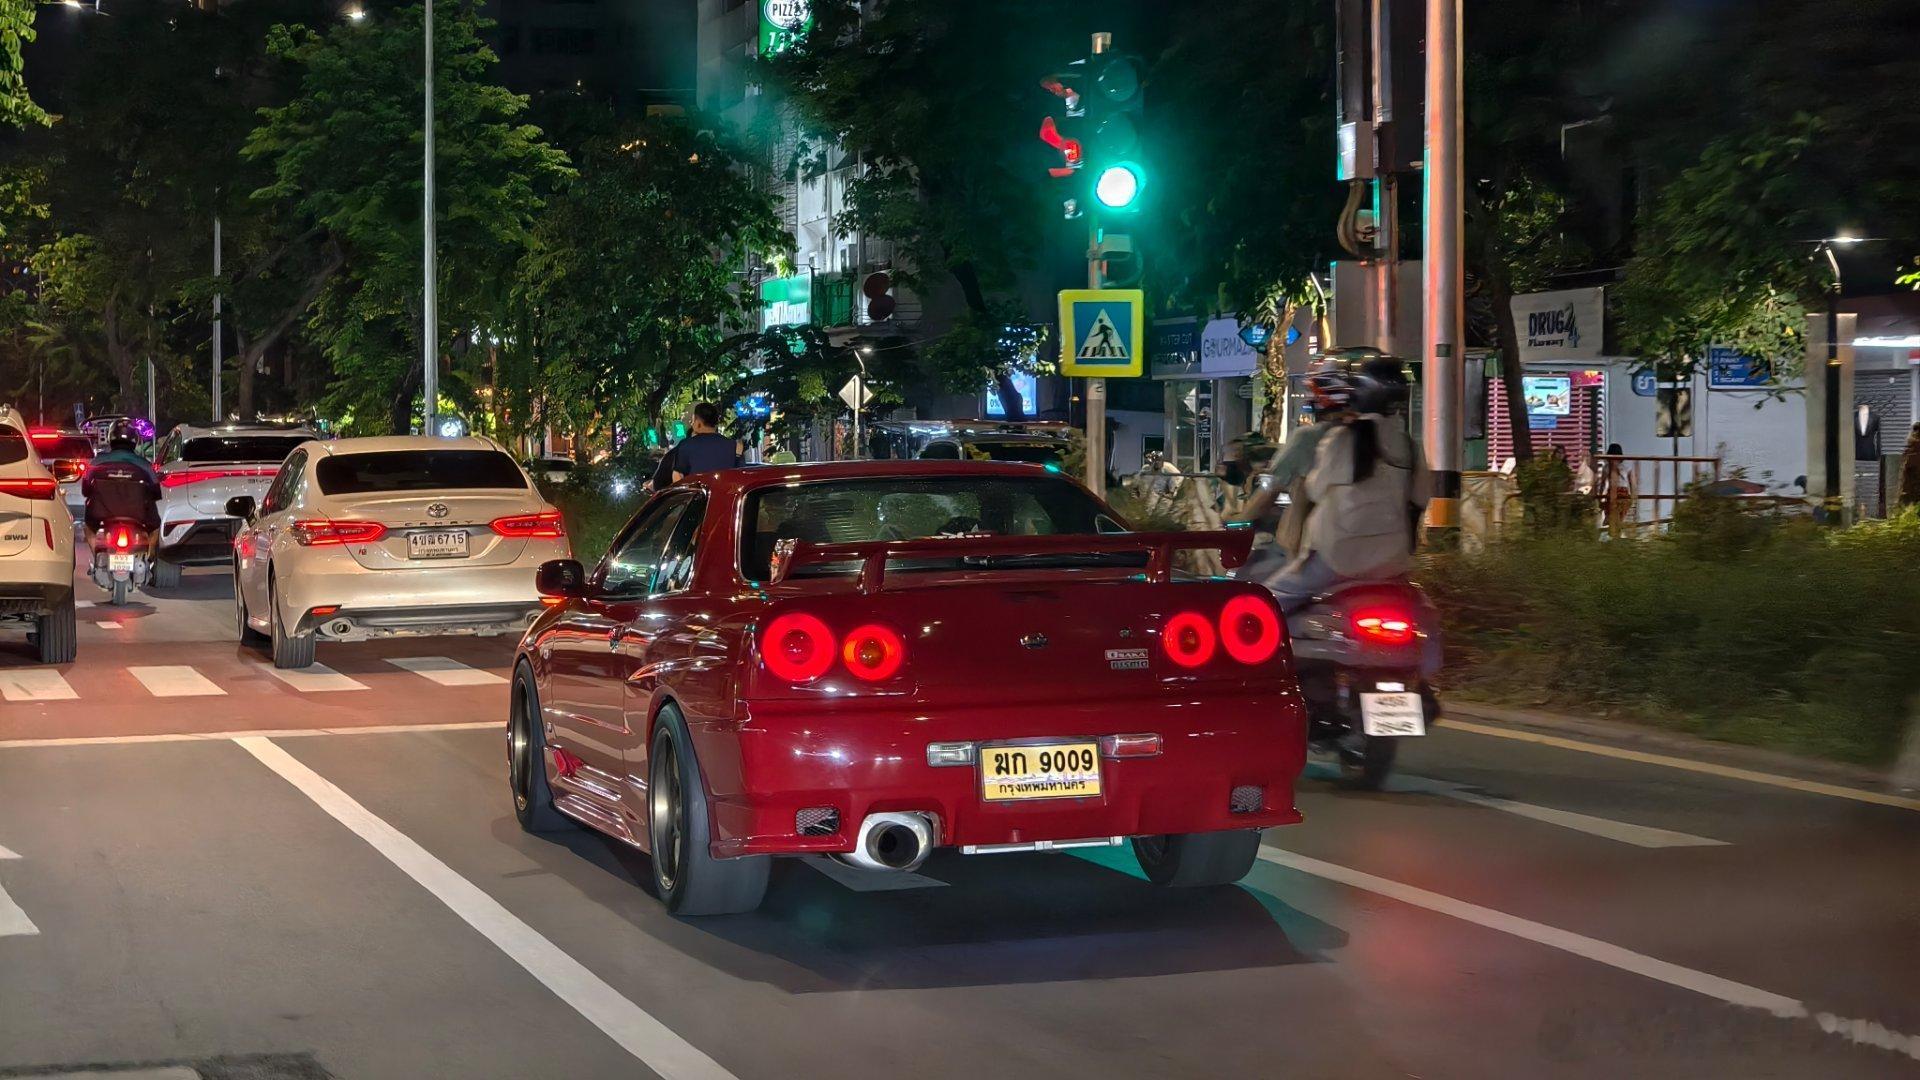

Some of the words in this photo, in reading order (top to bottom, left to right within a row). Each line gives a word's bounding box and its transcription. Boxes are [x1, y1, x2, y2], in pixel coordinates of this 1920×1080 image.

[772, 3, 802, 17] PIZZ
[4, 533, 29, 541] GWM
[437, 533, 464, 545] 6715
[1039, 749, 1093, 773] 9009
[999, 780, 1086, 796] กรุงเทพมหานคร
